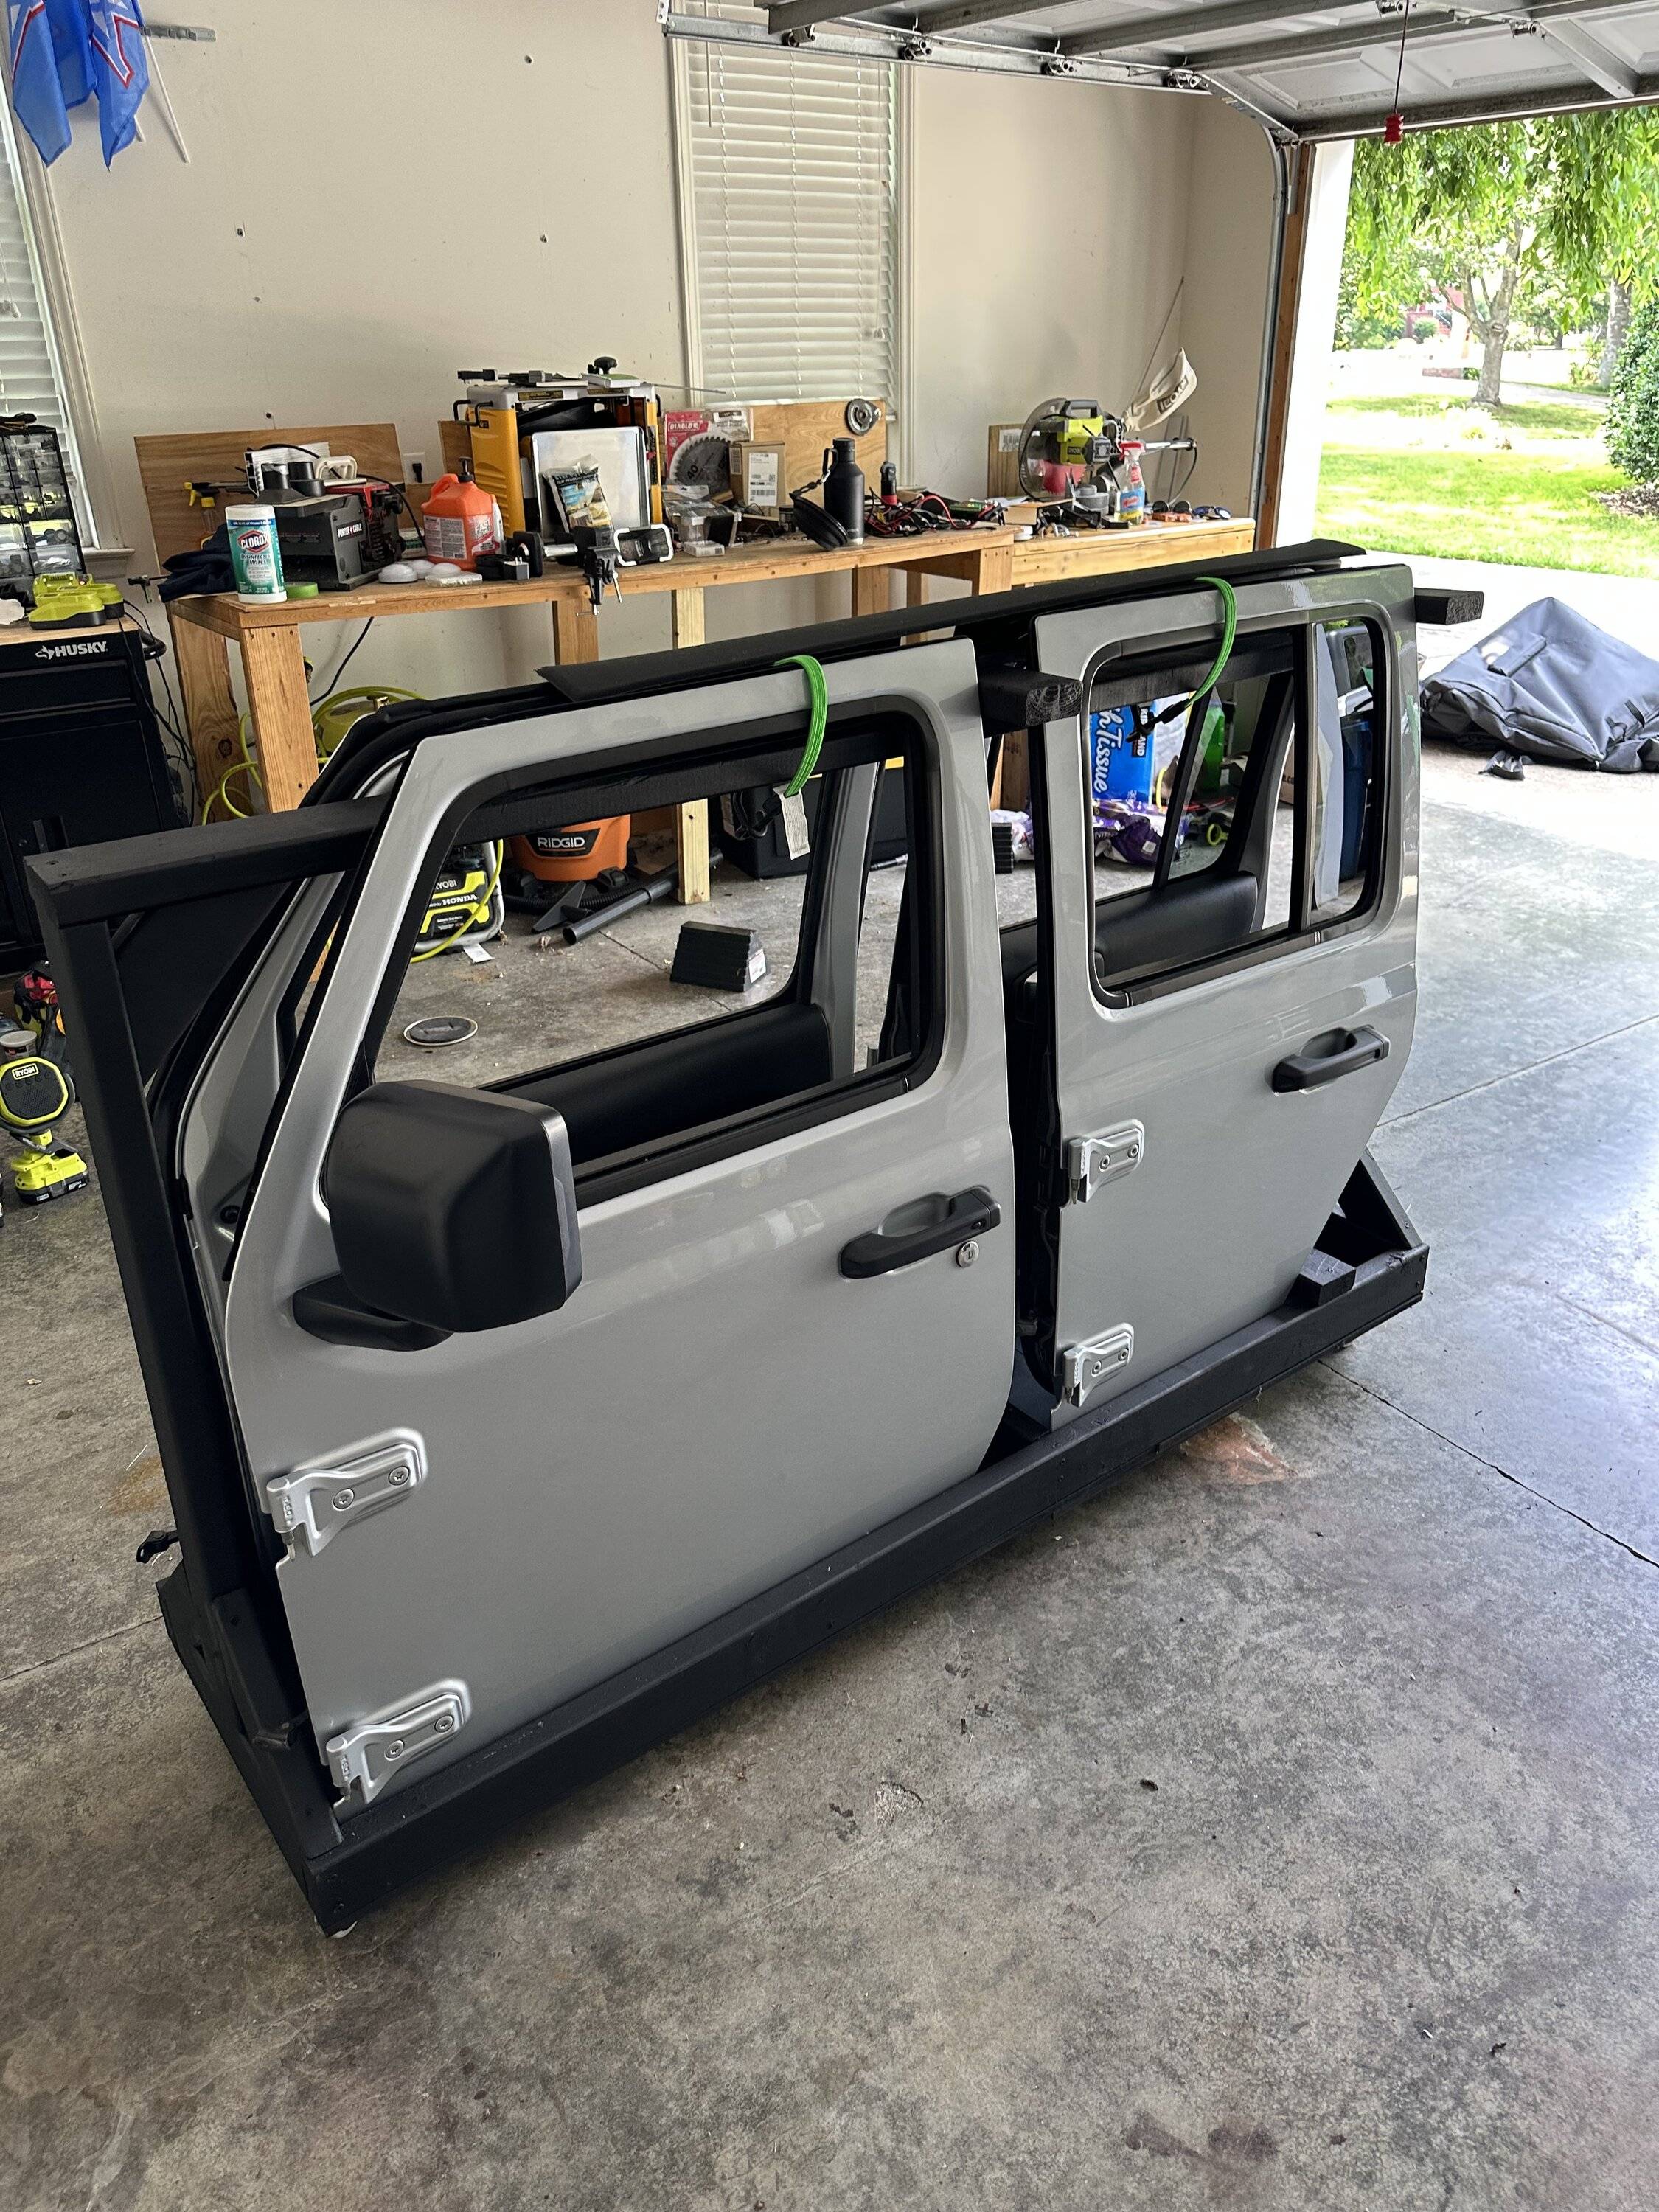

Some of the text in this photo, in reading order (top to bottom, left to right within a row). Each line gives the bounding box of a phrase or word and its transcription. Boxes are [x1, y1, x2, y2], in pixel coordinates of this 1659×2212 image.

[669, 422, 692, 431] DIABLO
[687, 465, 698, 479] 40
[240, 533, 270, 550] CLOROX
[54, 641, 107, 657] HUSKY
[1137, 708, 1149, 756] KIRAND
[1093, 727, 1123, 793] Tissue
[538, 837, 585, 848] RIDGID
[442, 894, 478, 905] HONDA
[15, 1066, 35, 1077] RYOBI
